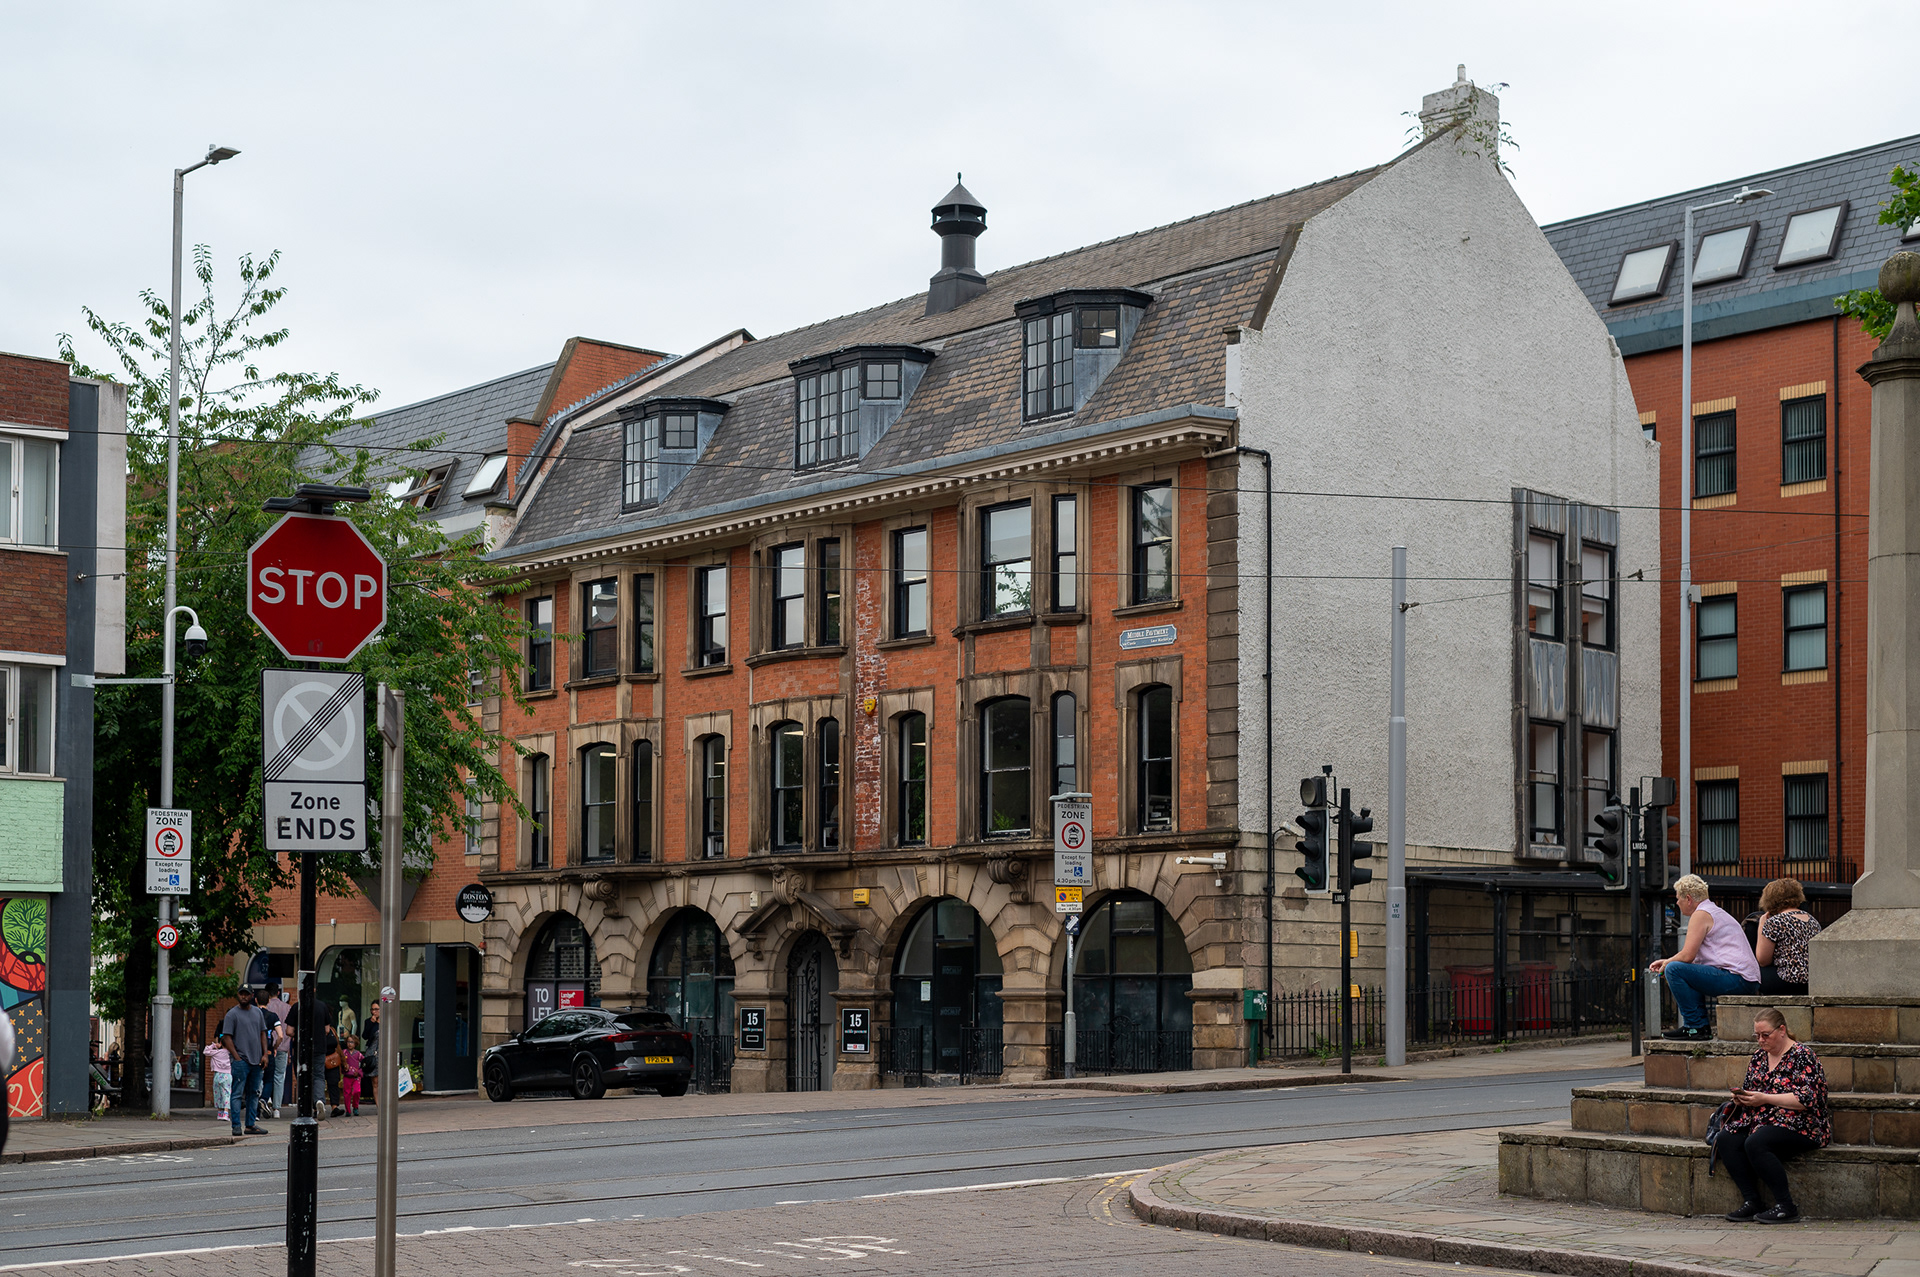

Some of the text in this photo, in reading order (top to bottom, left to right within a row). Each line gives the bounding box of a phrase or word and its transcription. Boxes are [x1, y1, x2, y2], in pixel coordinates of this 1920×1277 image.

[258, 567, 377, 610] STOP
[291, 792, 340, 810] Zone
[150, 810, 189, 818] PEDESTRIAN
[1061, 811, 1085, 819] ZONE
[156, 817, 182, 826] ZONE
[277, 817, 355, 840] ENDS
[462, 892, 489, 901] BOSTON
[160, 931, 175, 942] 20
[534, 987, 549, 1003] TO
[532, 1006, 552, 1022] LET
[747, 1012, 759, 1026] 15
[849, 1013, 862, 1028] 15
